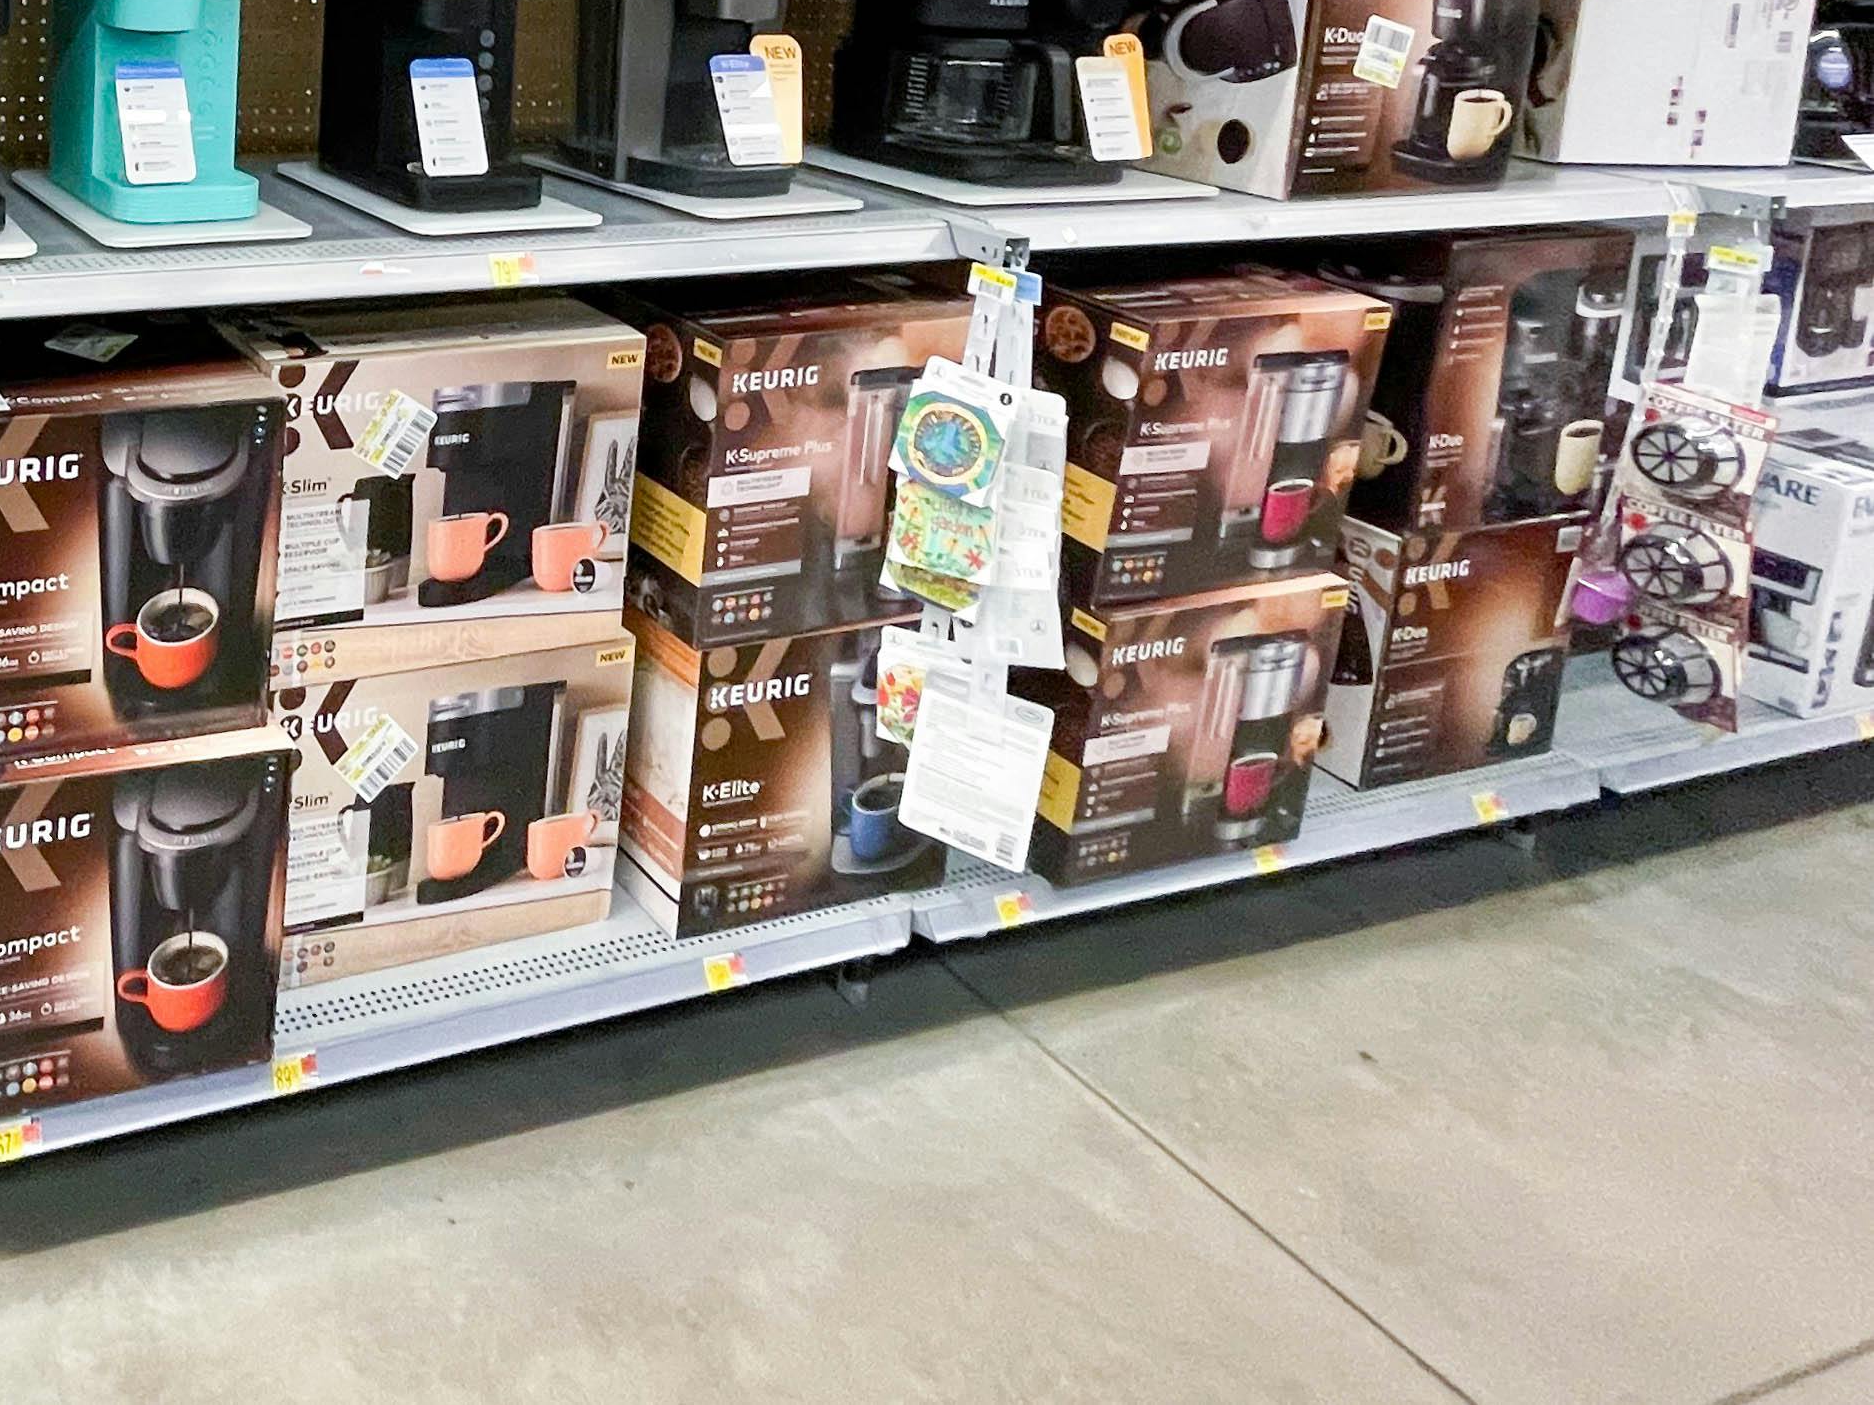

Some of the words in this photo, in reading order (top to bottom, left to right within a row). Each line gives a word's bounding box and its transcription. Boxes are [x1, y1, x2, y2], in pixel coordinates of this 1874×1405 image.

[764, 46, 797, 60] NEW
[1110, 41, 1137, 56] NEW
[611, 352, 638, 366] NEW
[1155, 348, 1229, 371] KEURIG
[733, 366, 820, 394] KEURIG
[434, 432, 470, 447] KEURIG
[804, 440, 833, 455] Plus
[1406, 558, 1471, 586] KEURIG
[600, 650, 626, 662] NEW
[1111, 637, 1187, 666] KEURIG
[709, 674, 811, 708] KEURIG
[432, 738, 466, 753] KEURIG
